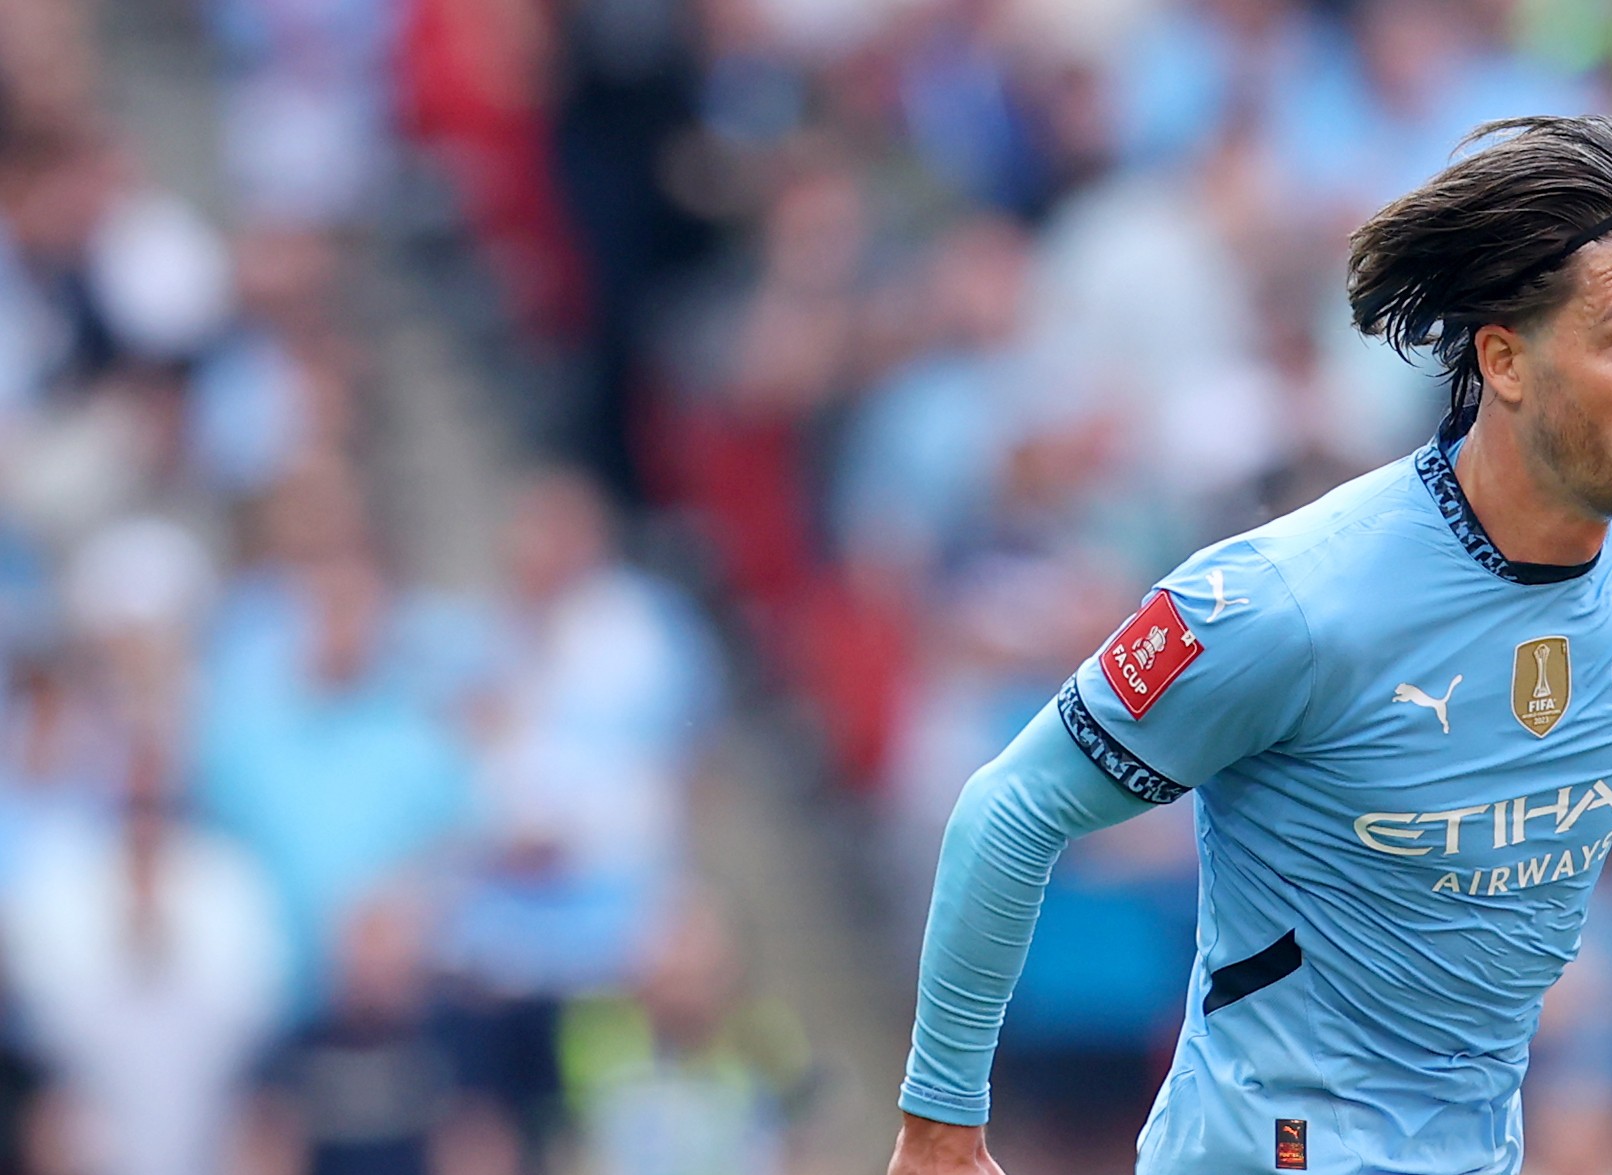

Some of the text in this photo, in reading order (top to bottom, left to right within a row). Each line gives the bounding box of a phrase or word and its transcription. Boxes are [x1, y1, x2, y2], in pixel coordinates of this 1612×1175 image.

[1112, 643, 1148, 695] FA CUP
[1528, 698, 1555, 713] FIFA
